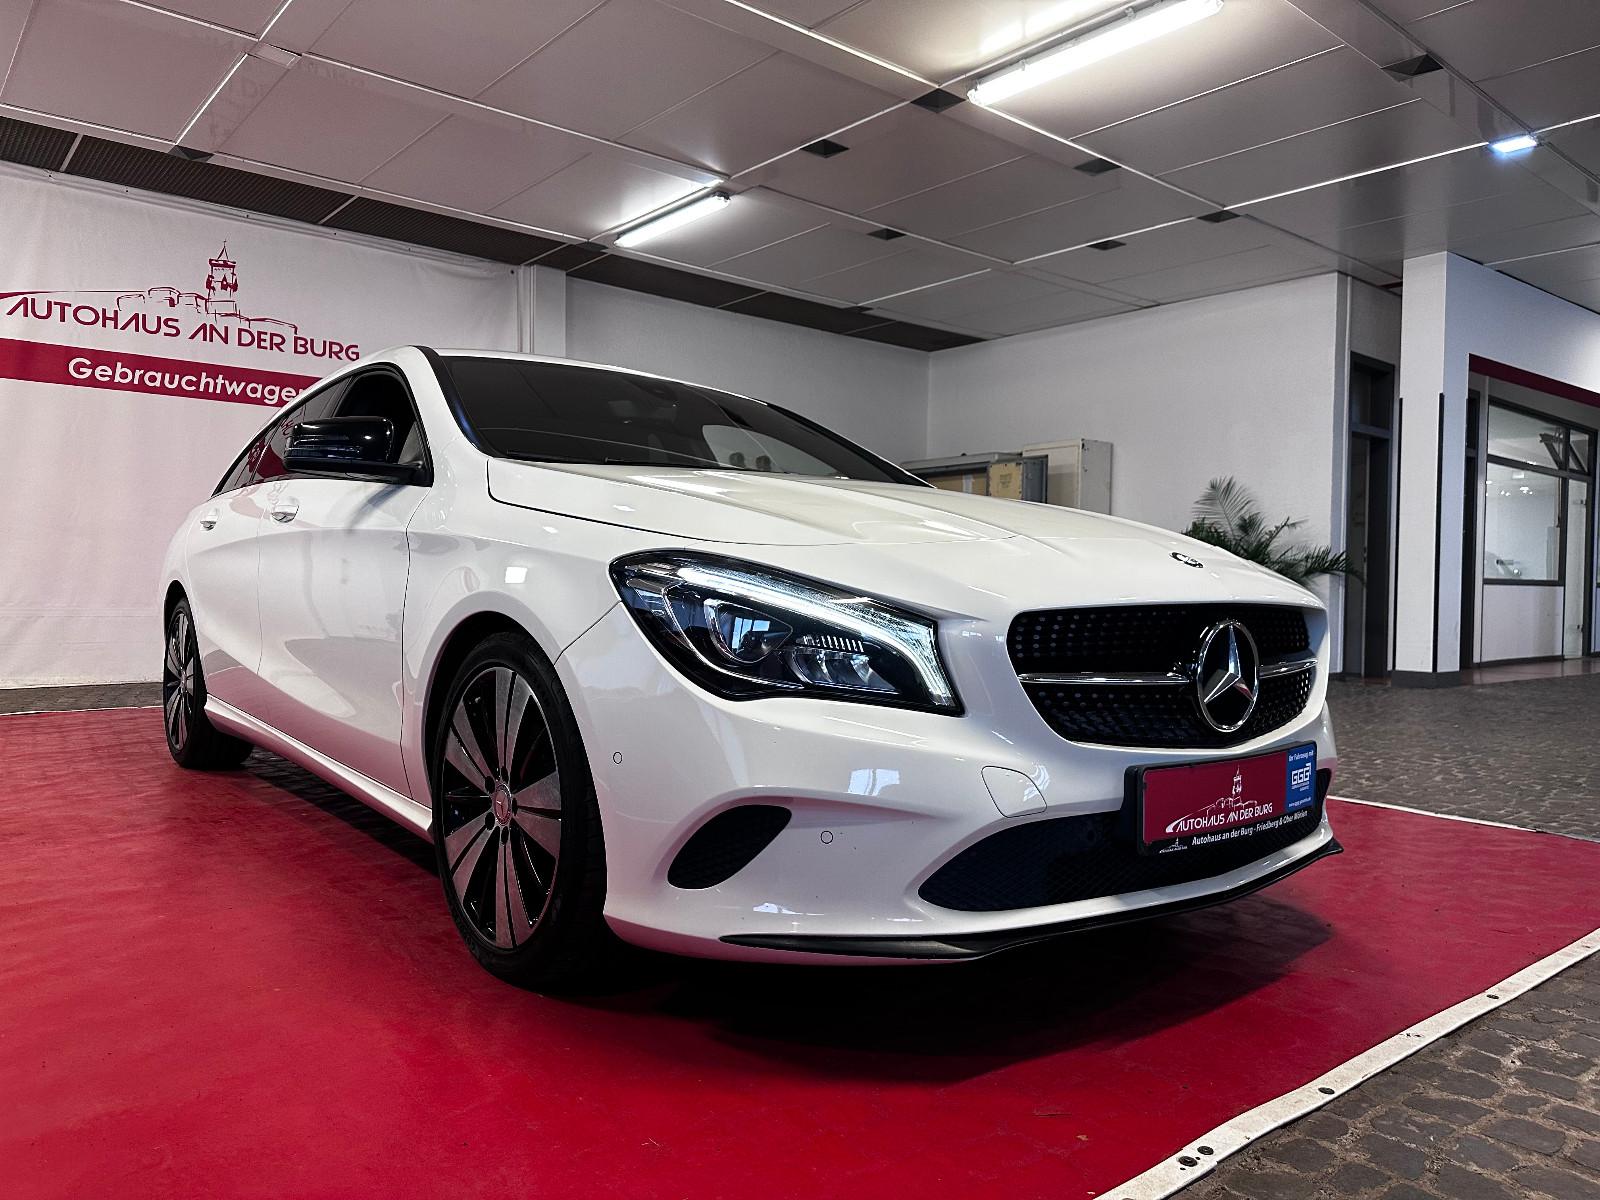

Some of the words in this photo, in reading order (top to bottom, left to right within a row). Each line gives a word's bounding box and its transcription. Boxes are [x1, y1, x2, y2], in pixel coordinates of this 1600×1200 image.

[6, 296, 181, 338] AUTOHAUS
[188, 322, 230, 345] AN
[237, 327, 287, 352] DER
[294, 335, 360, 362] BURG
[67, 357, 305, 403] Gebrauchtwage
[1291, 764, 1311, 786] GGG
[1176, 813, 1225, 833] AUTOHAUS
[1226, 810, 1239, 824] AN
[1239, 807, 1254, 821] DER
[1254, 802, 1273, 817] BURG
[1191, 833, 1222, 846] Autohaus
[1222, 831, 1230, 840] an
[1230, 828, 1240, 838] der
[1240, 826, 1254, 836] Burg
[1256, 820, 1279, 832] Friedberg
